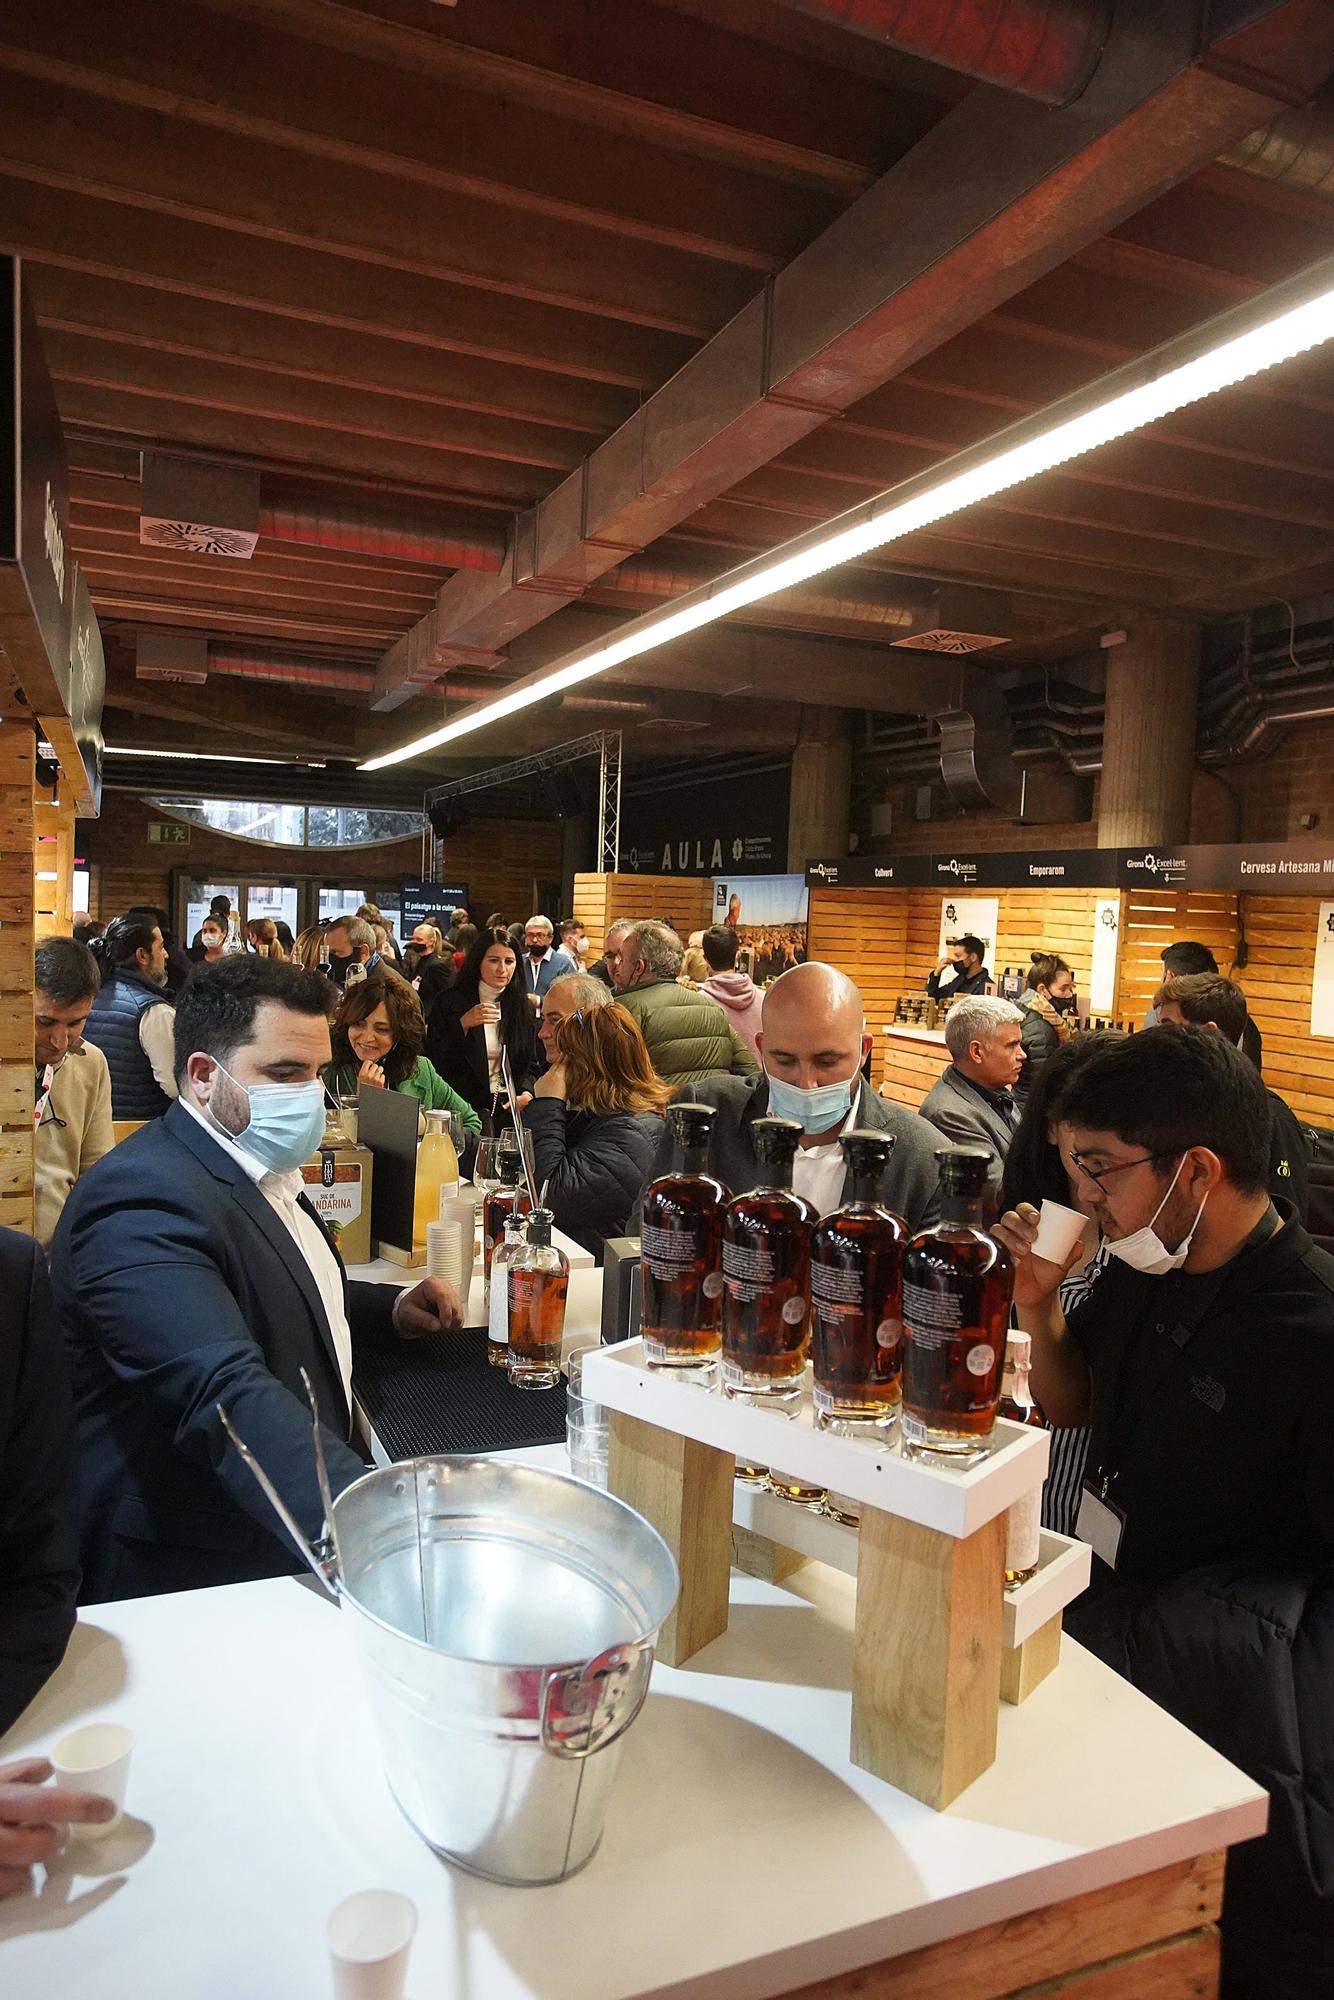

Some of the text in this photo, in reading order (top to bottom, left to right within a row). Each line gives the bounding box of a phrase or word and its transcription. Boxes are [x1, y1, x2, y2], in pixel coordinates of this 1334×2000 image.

[661, 838, 723, 871] AULA
[1126, 859, 1145, 868] Girona
[1240, 861, 1276, 874] Cervesa
[1278, 860, 1320, 873] Artesana
[1029, 865, 1065, 878] Emporarom
